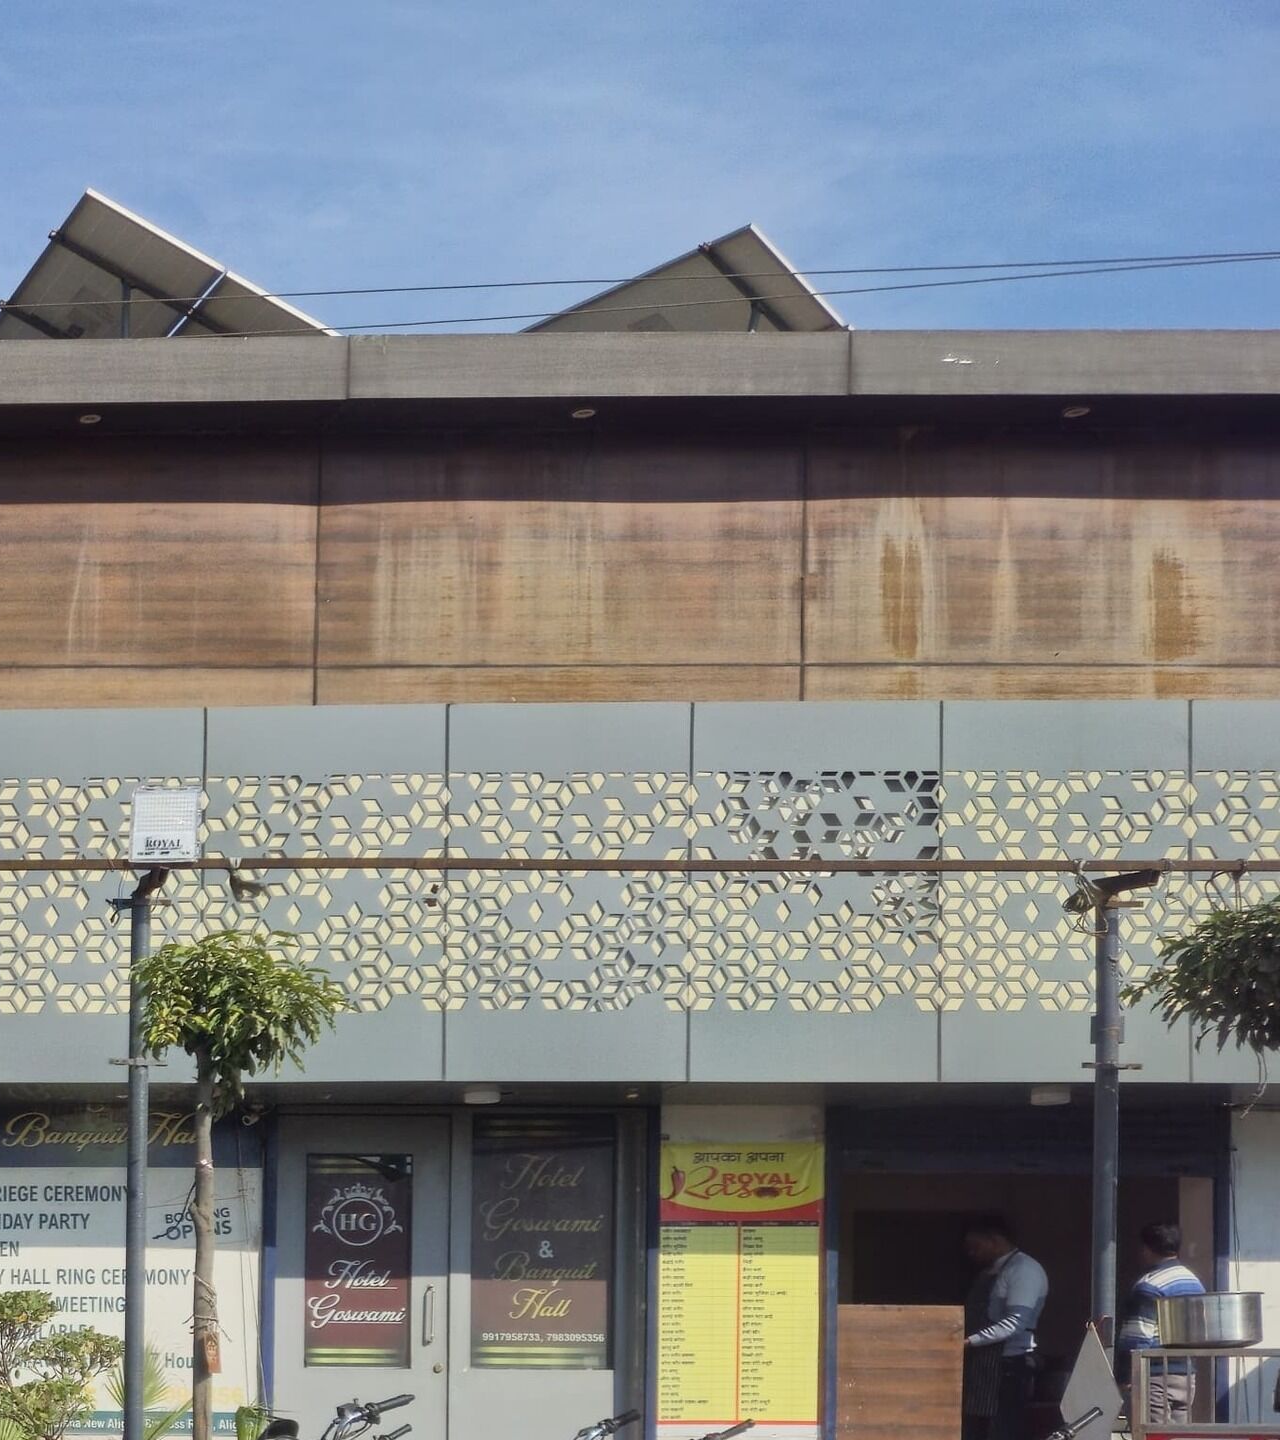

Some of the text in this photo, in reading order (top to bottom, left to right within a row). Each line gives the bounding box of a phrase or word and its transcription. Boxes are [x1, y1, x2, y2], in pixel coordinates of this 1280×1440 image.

[746, 1152, 785, 1164] अपना
[500, 1153, 586, 1190] Hotel
[721, 1172, 798, 1184] ROYAL
[39, 1213, 90, 1230] PARTY
[165, 1207, 231, 1224] BOONG
[339, 1212, 377, 1232] HG
[479, 1197, 605, 1241] Goswami
[167, 1220, 233, 1241] OPNS
[539, 1240, 554, 1258] &
[11, 1268, 50, 1285] HALL
[56, 1268, 95, 1285] RING
[101, 1268, 191, 1286] CEMONY
[324, 1260, 391, 1290] Hotel
[308, 1294, 406, 1329] Goswami
[509, 1288, 573, 1320] Hall
[165, 1352, 194, 1369] Hou
